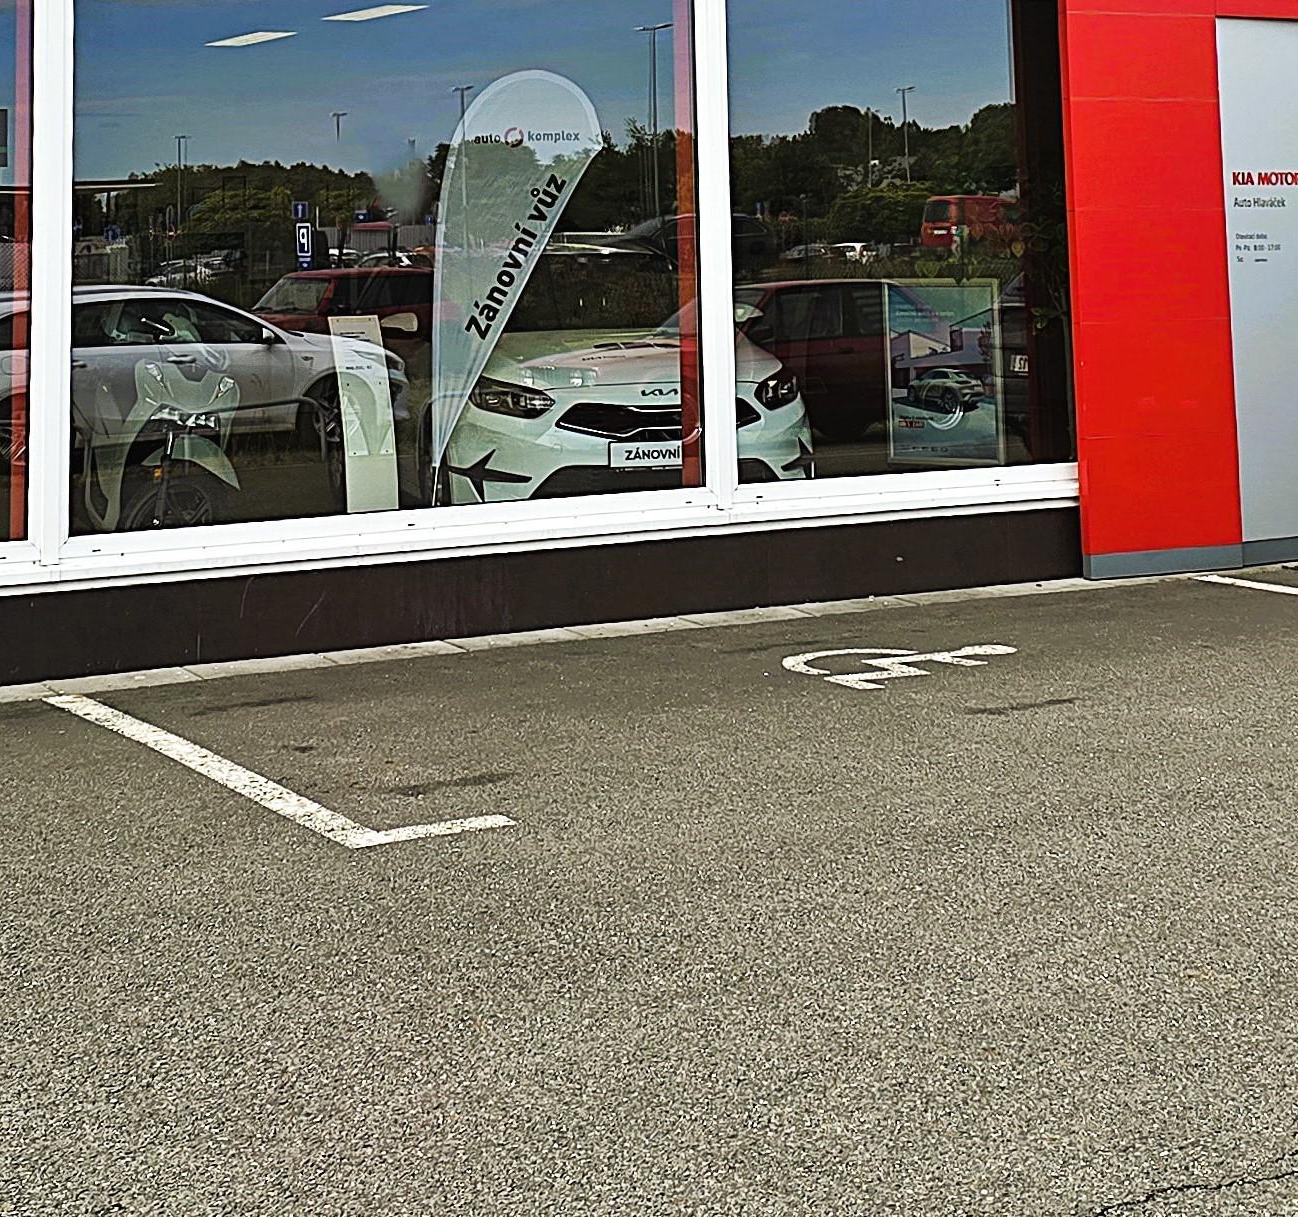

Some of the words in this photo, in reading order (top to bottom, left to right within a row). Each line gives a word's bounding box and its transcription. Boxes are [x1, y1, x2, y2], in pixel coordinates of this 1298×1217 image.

[474, 134, 501, 145] auto
[527, 130, 581, 143] komplex
[1232, 171, 1255, 186] KIA
[1233, 197, 1252, 208] Auto
[464, 222, 538, 341] Zánovní
[527, 173, 567, 223] vůz
[624, 445, 681, 461] ZÁNOVNÍ
